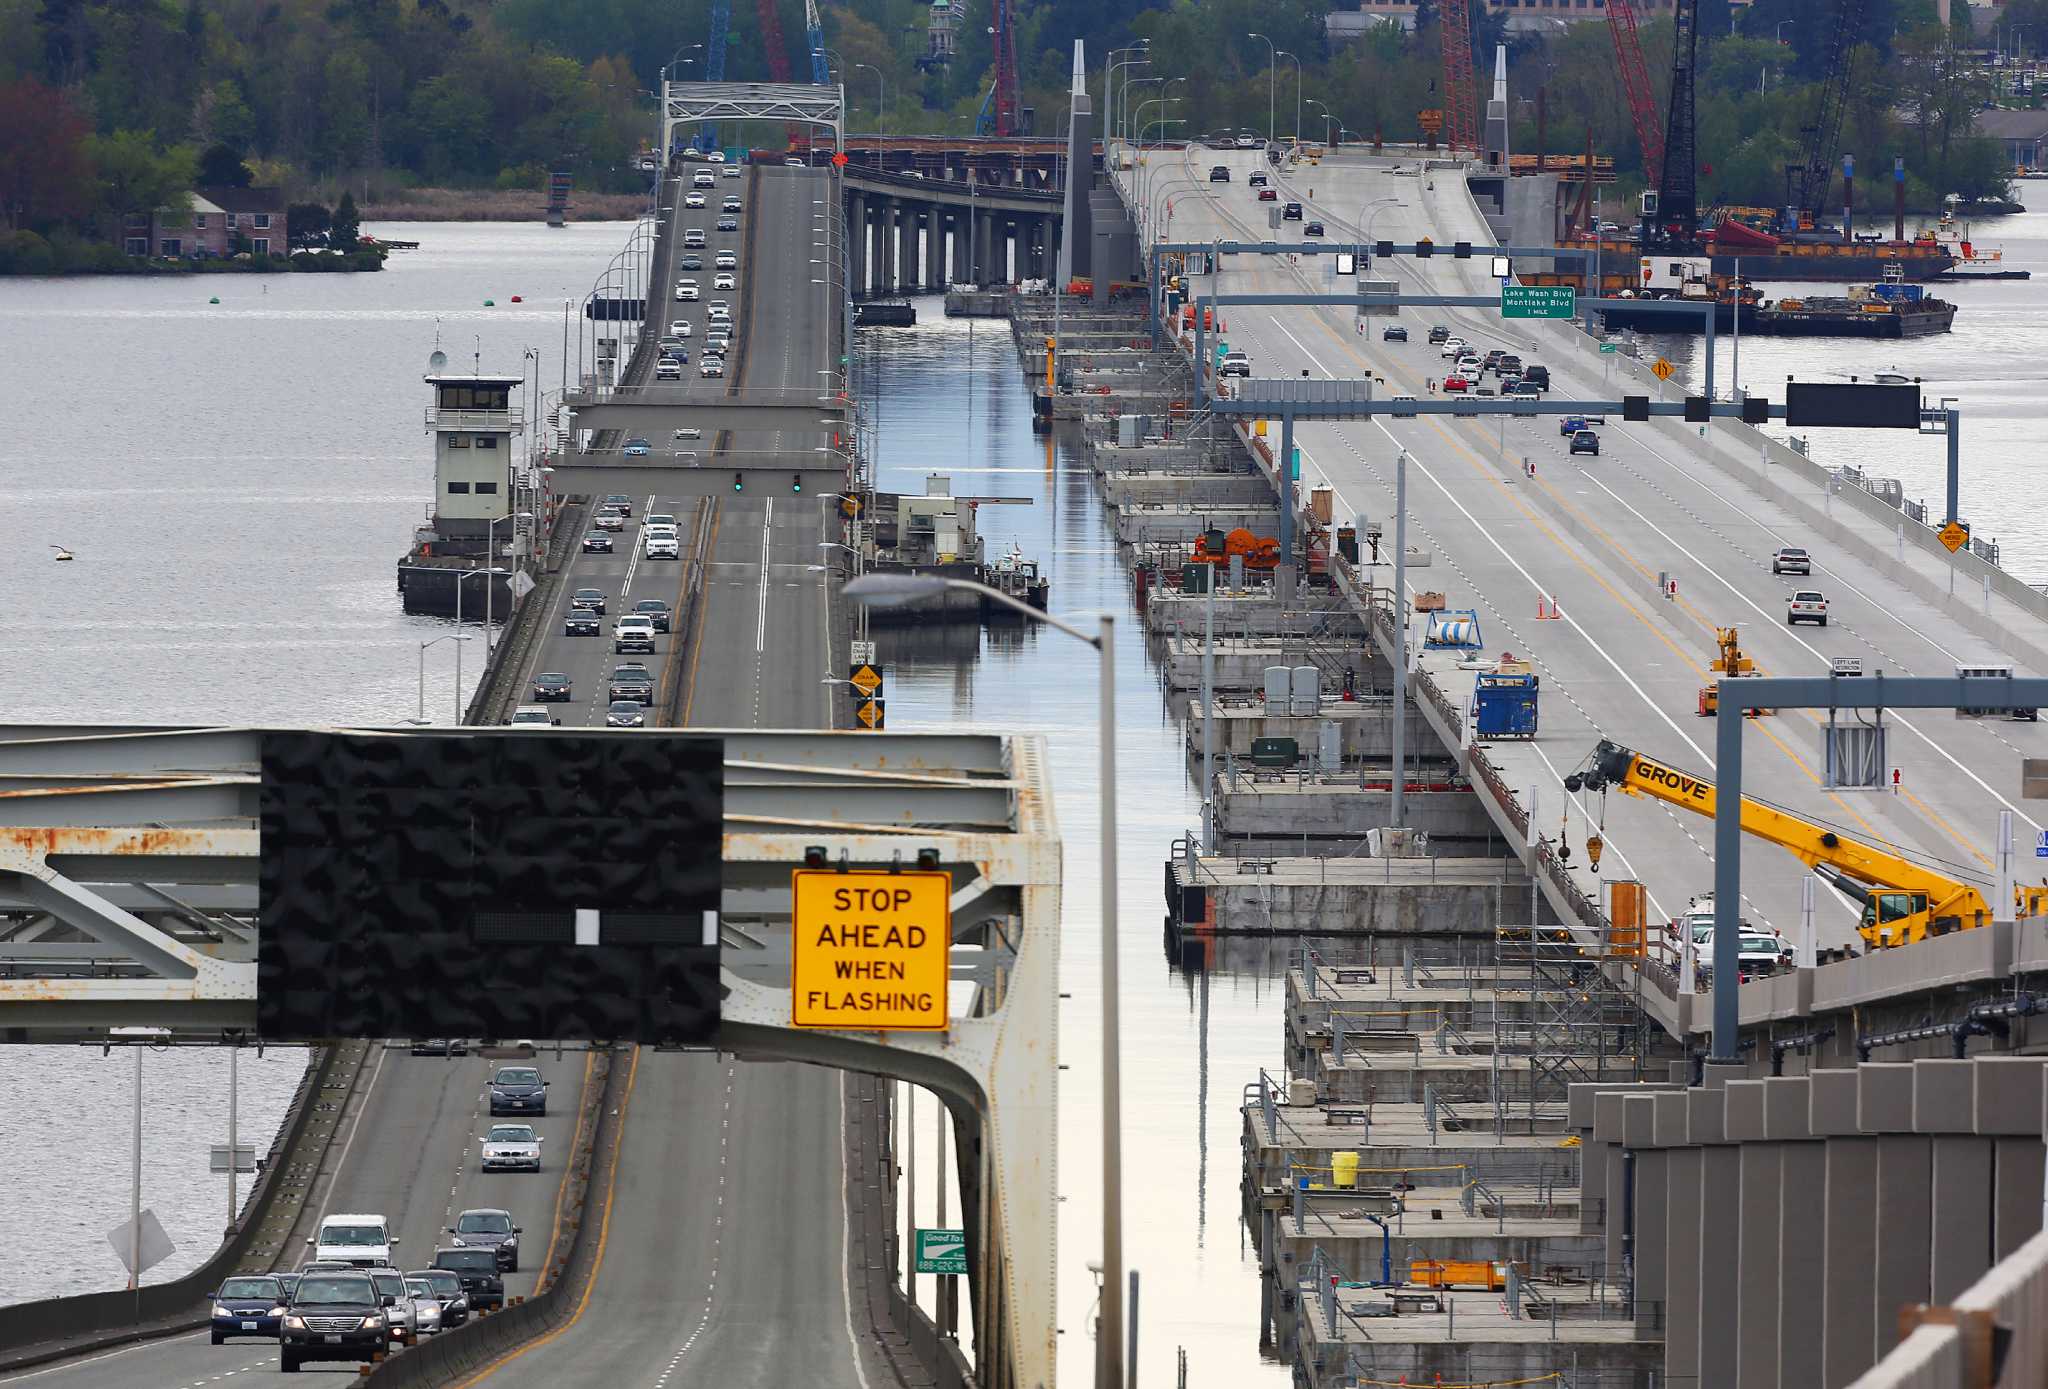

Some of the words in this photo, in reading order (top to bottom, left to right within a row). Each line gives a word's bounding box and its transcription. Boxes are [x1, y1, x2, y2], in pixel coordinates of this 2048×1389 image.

[1635, 762, 1710, 800] GROVE
[834, 888, 912, 912] STOP
[816, 924, 926, 948] AHEAD
[834, 961, 905, 980] WHEN
[808, 991, 932, 1012] FLASHING
[926, 1233, 948, 1242] Good
[950, 1234, 960, 1242] To
